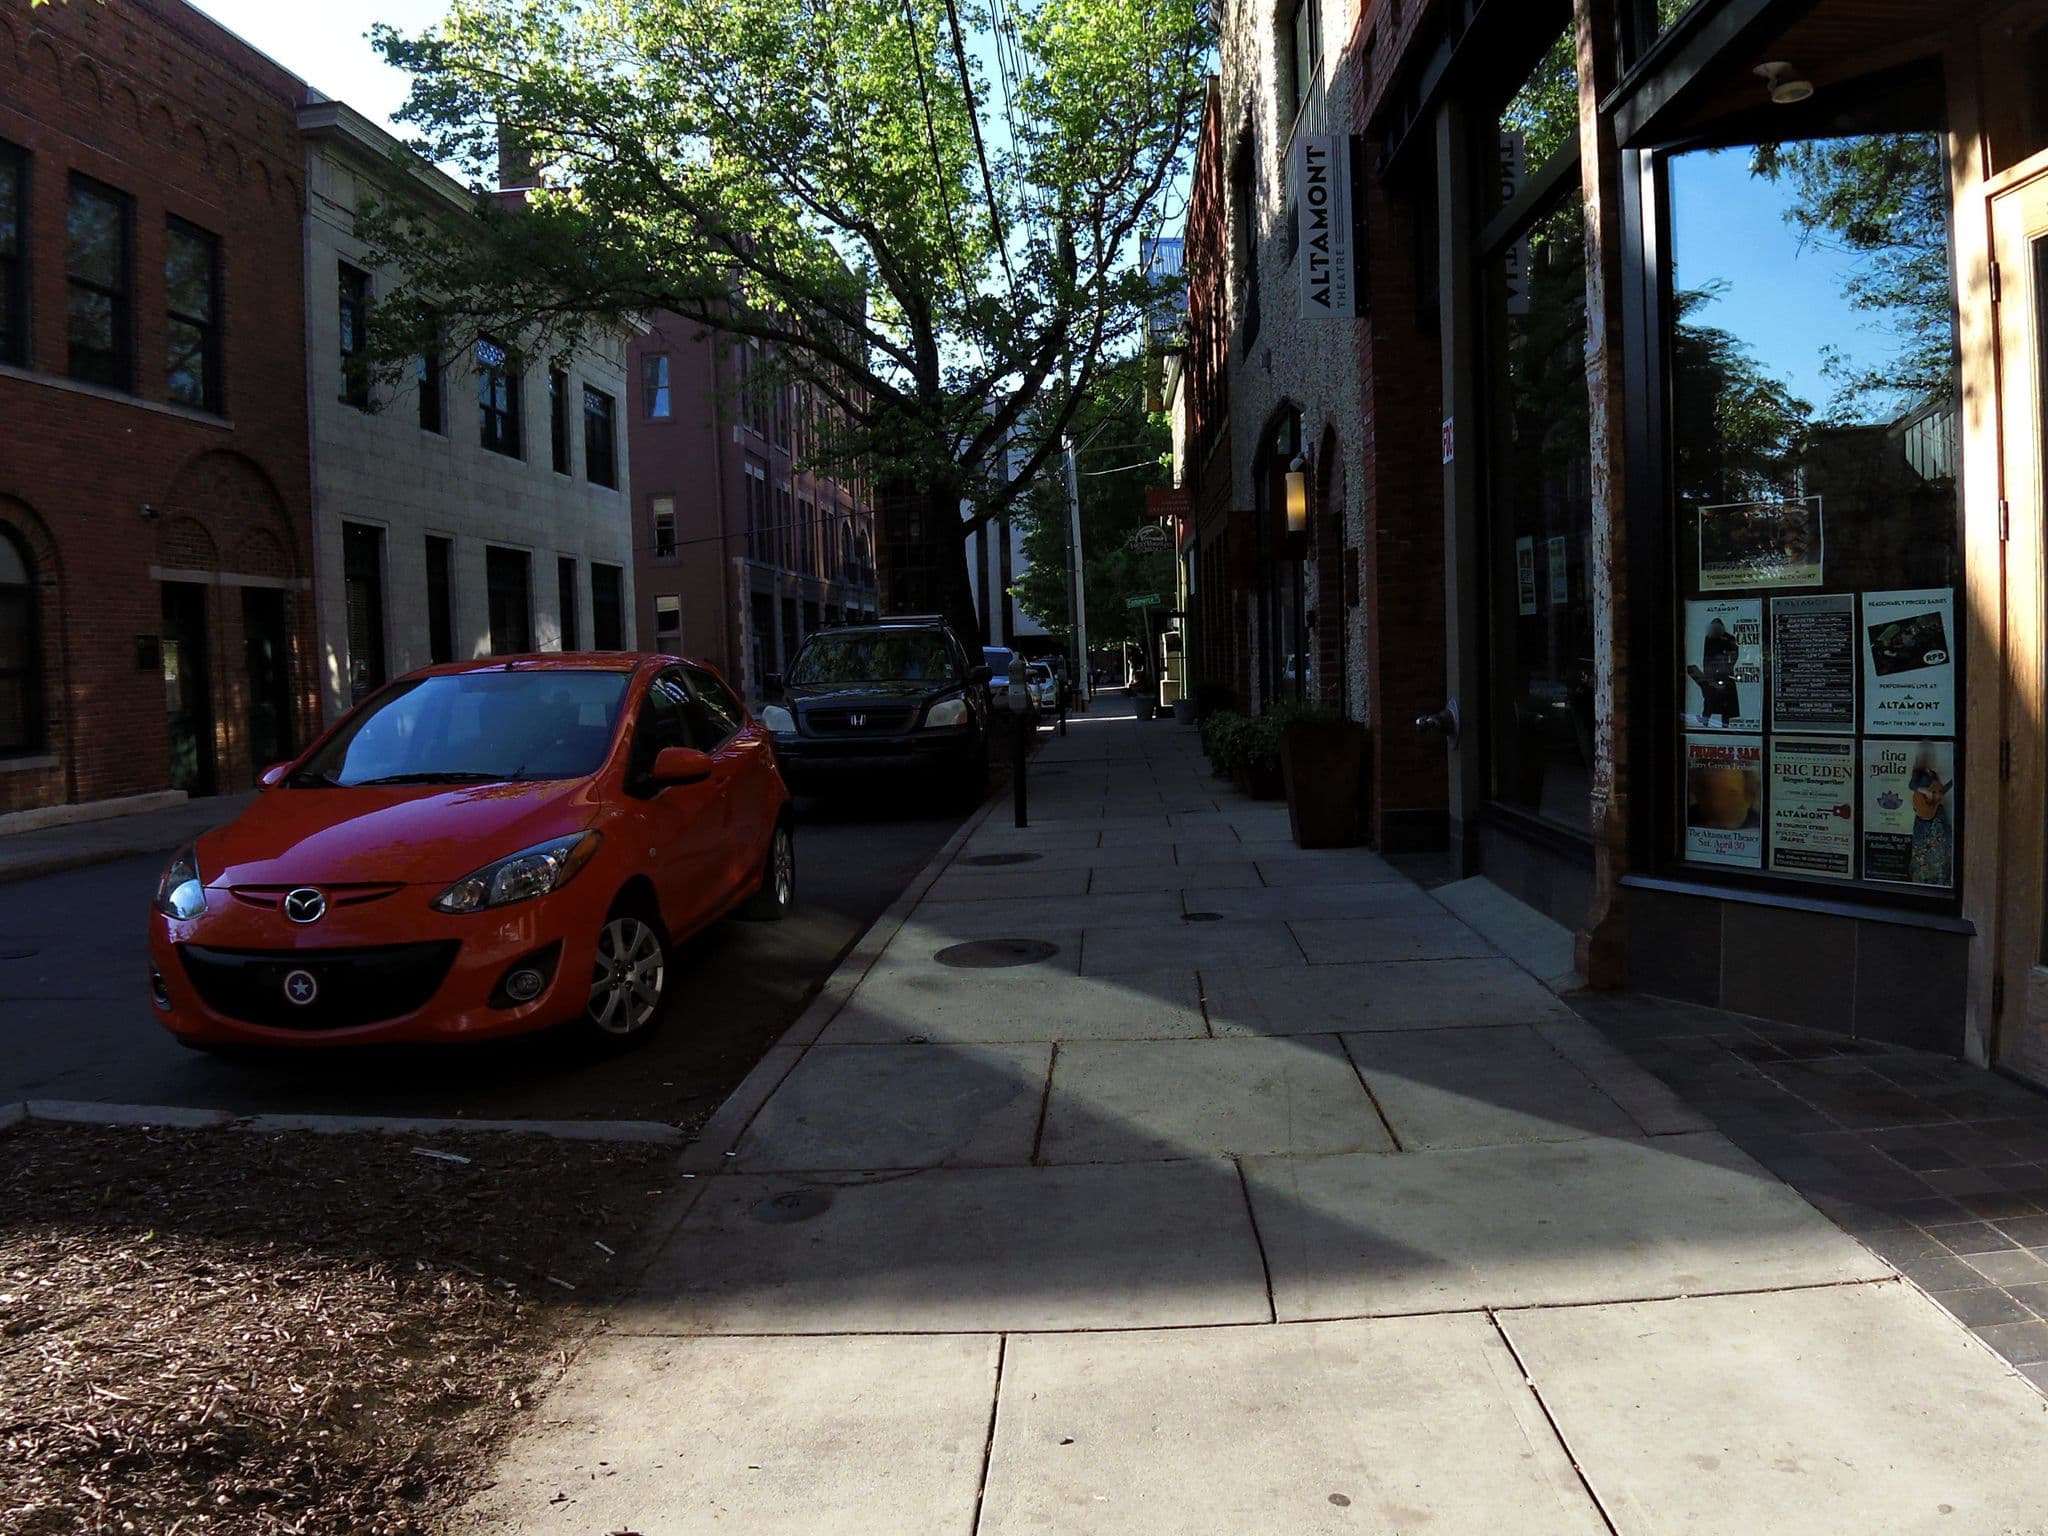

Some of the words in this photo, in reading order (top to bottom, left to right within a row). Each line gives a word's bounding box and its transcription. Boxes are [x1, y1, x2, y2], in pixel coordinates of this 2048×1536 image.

[1306, 145, 1331, 309] ALTAMONT
[1335, 249, 1345, 309] THEATRE
[1733, 623, 1760, 634] JOHNNY
[1736, 633, 1760, 645] CASH
[1926, 653, 1944, 662] RPB
[1878, 701, 1940, 710] ALTAMONT
[1881, 749, 1906, 762] tina
[1774, 763, 1808, 776] ERIC
[1812, 765, 1852, 778] EDEN
[1775, 810, 1830, 820] ALTAMONT
[1689, 828, 1701, 837] The
[1702, 830, 1731, 840] Altamont
[1713, 840, 1733, 850] April
